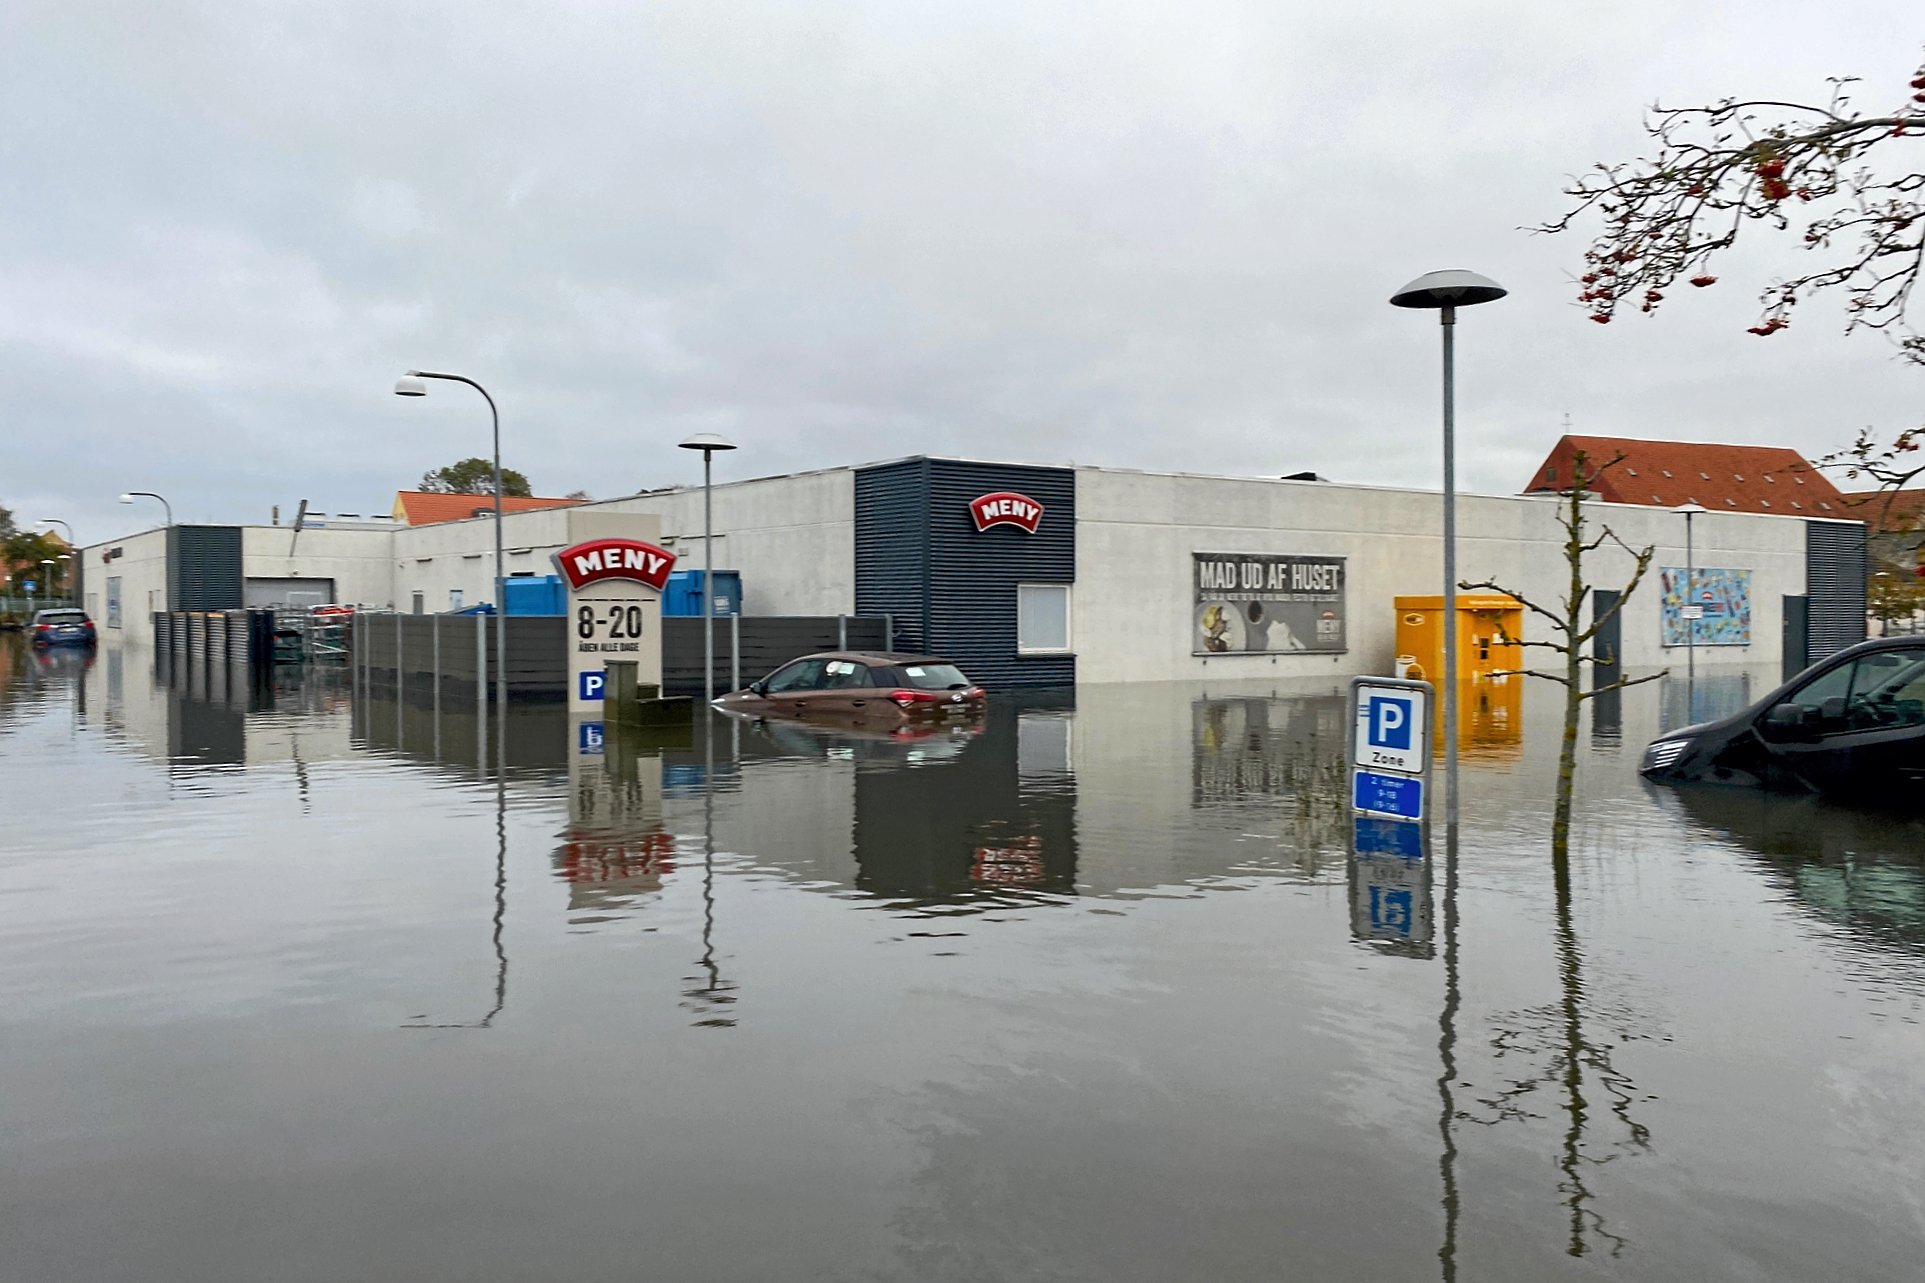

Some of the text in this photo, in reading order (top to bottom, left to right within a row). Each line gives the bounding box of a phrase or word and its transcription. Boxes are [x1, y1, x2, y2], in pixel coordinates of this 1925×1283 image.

[980, 499, 1039, 521] MENY
[573, 548, 667, 576] MENY
[1199, 561, 1340, 591] MAD UD AF HUSET
[578, 605, 642, 638] 8-20
[578, 641, 639, 652] ÅBEN ALLE DAGE
[586, 676, 602, 696] P
[1378, 702, 1404, 742] P
[1372, 751, 1405, 767] Zone
[1371, 777, 1377, 785] 2
